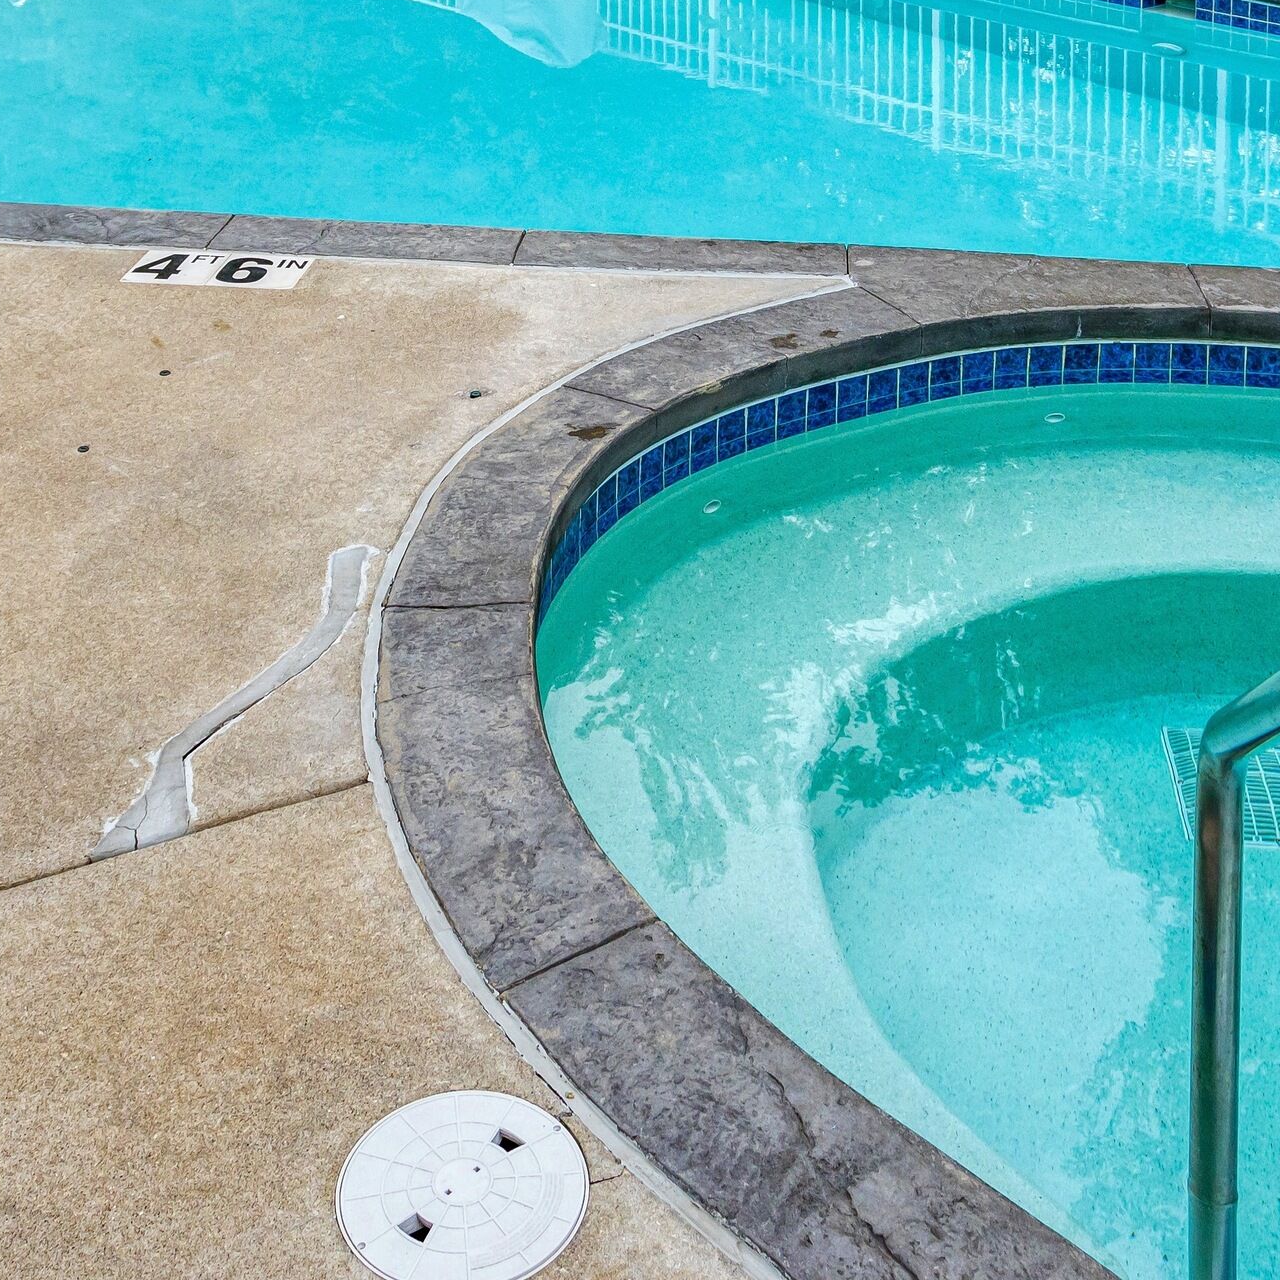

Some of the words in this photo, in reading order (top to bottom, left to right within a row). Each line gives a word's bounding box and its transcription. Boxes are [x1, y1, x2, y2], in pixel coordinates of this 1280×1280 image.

[132, 253, 190, 280] 4
[191, 254, 224, 264] FT
[215, 257, 274, 284] 6
[277, 259, 309, 269] IN
